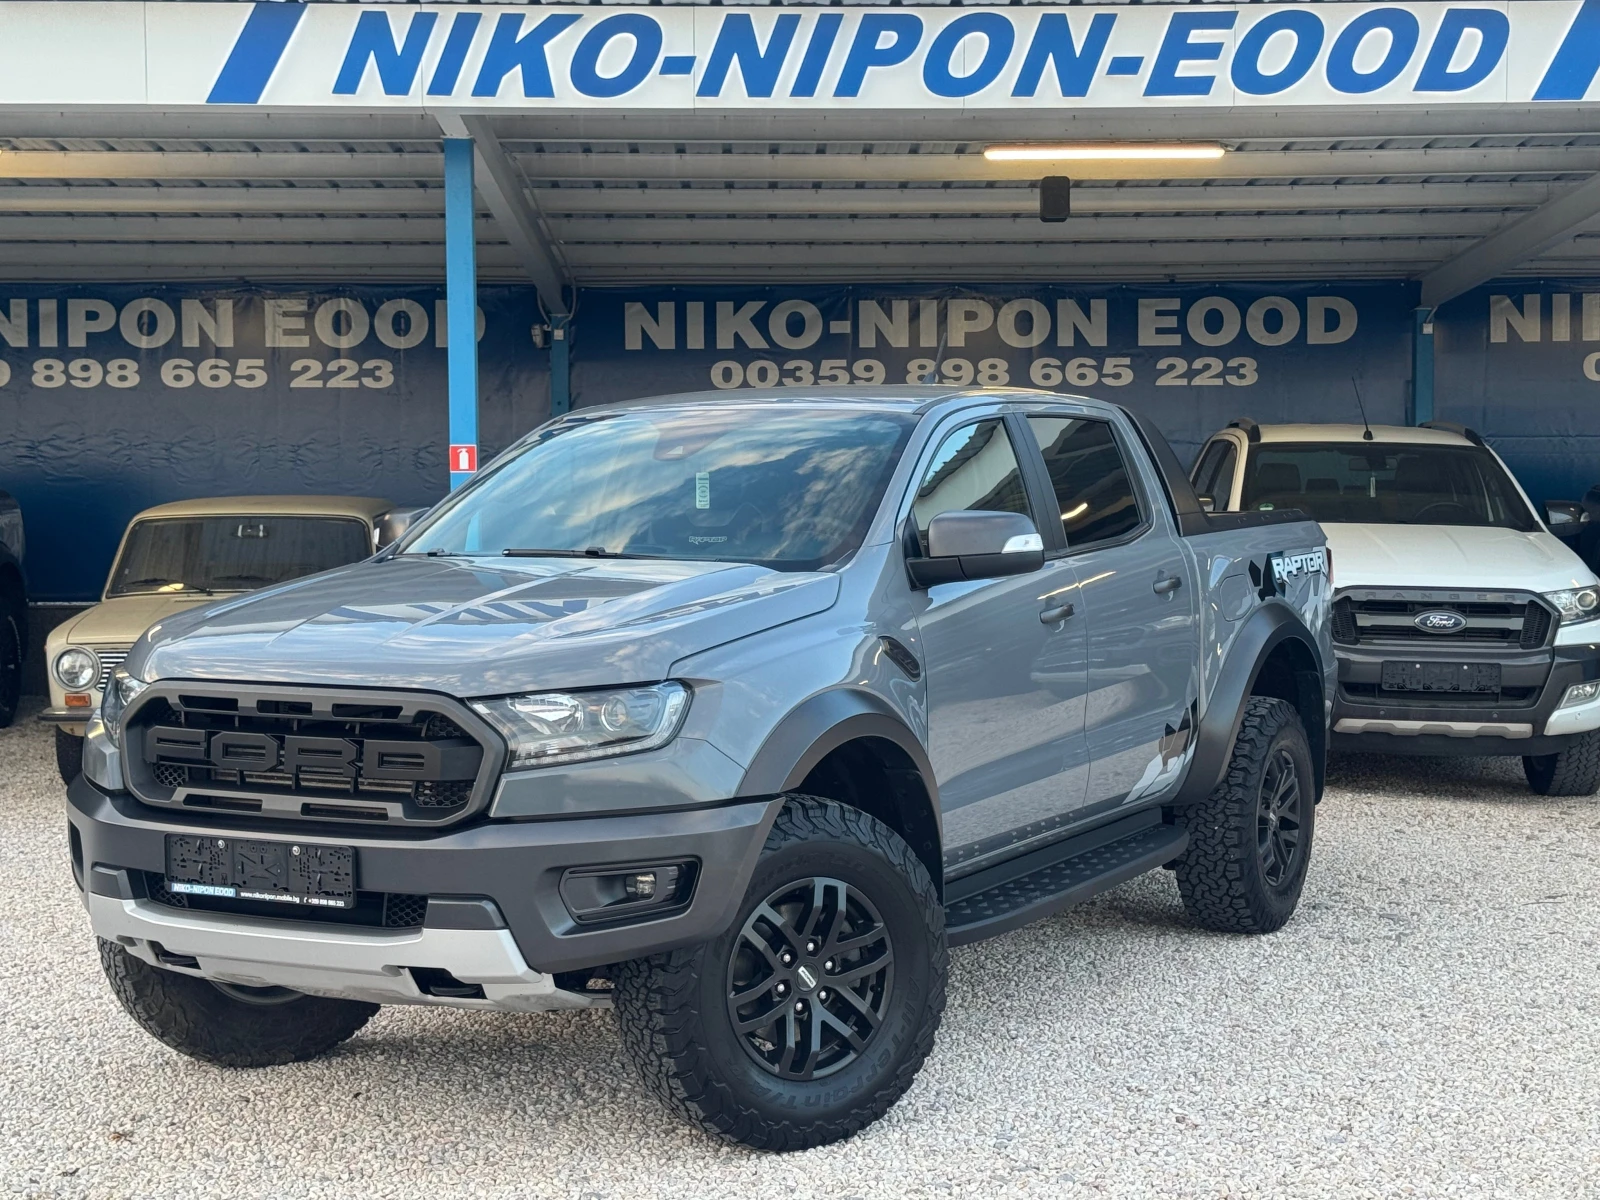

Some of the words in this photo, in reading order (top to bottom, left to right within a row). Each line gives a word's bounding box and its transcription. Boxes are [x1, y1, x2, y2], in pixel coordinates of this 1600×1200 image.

[332, 8, 1510, 99] NIKO-NIPON-EOOD
[624, 298, 1108, 350] NIKO-NIPON
[1138, 296, 1358, 346] EOOD
[32, 358, 140, 388] 898
[160, 358, 268, 388] 665
[290, 358, 395, 388] 223
[711, 358, 886, 389] 00359
[906, 358, 1010, 387] 898
[1030, 357, 1134, 386] 665
[1155, 357, 1259, 386] 223
[1271, 551, 1327, 587] RAPTOR
[1364, 591, 1516, 601] RANGER
[1426, 615, 1455, 627] Ford
[147, 725, 441, 781] FORD
[173, 883, 214, 895] NIKO-NIPON
